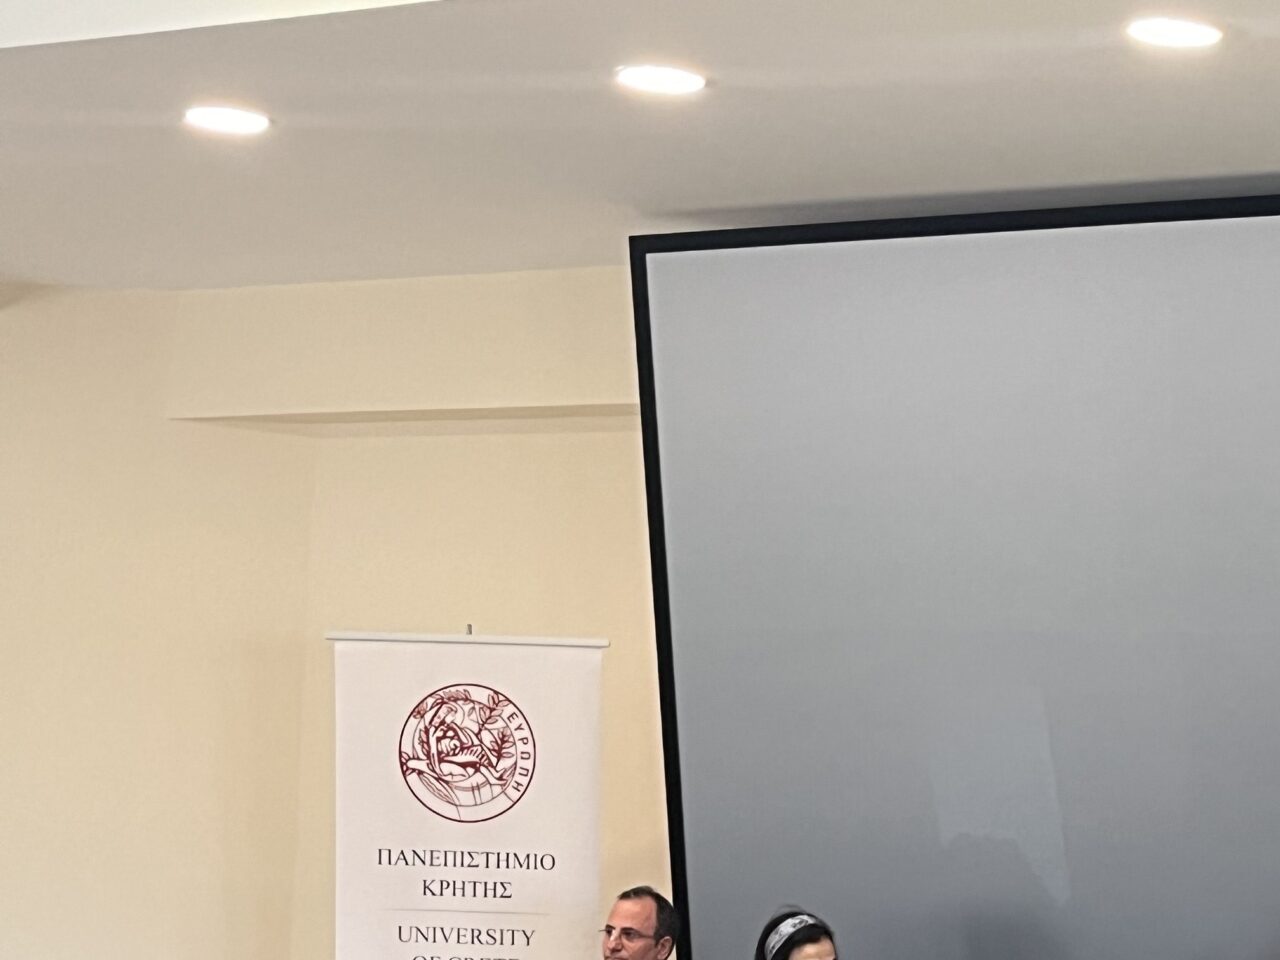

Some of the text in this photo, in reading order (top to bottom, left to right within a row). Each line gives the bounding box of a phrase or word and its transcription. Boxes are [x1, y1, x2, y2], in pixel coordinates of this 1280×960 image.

[377, 848, 556, 871] ΠΑΝΕΠΙΣΤΗΜΙΟ
[422, 879, 513, 899] ΚΡΗΤΗΣ
[397, 925, 536, 947] UNIVERSITY
